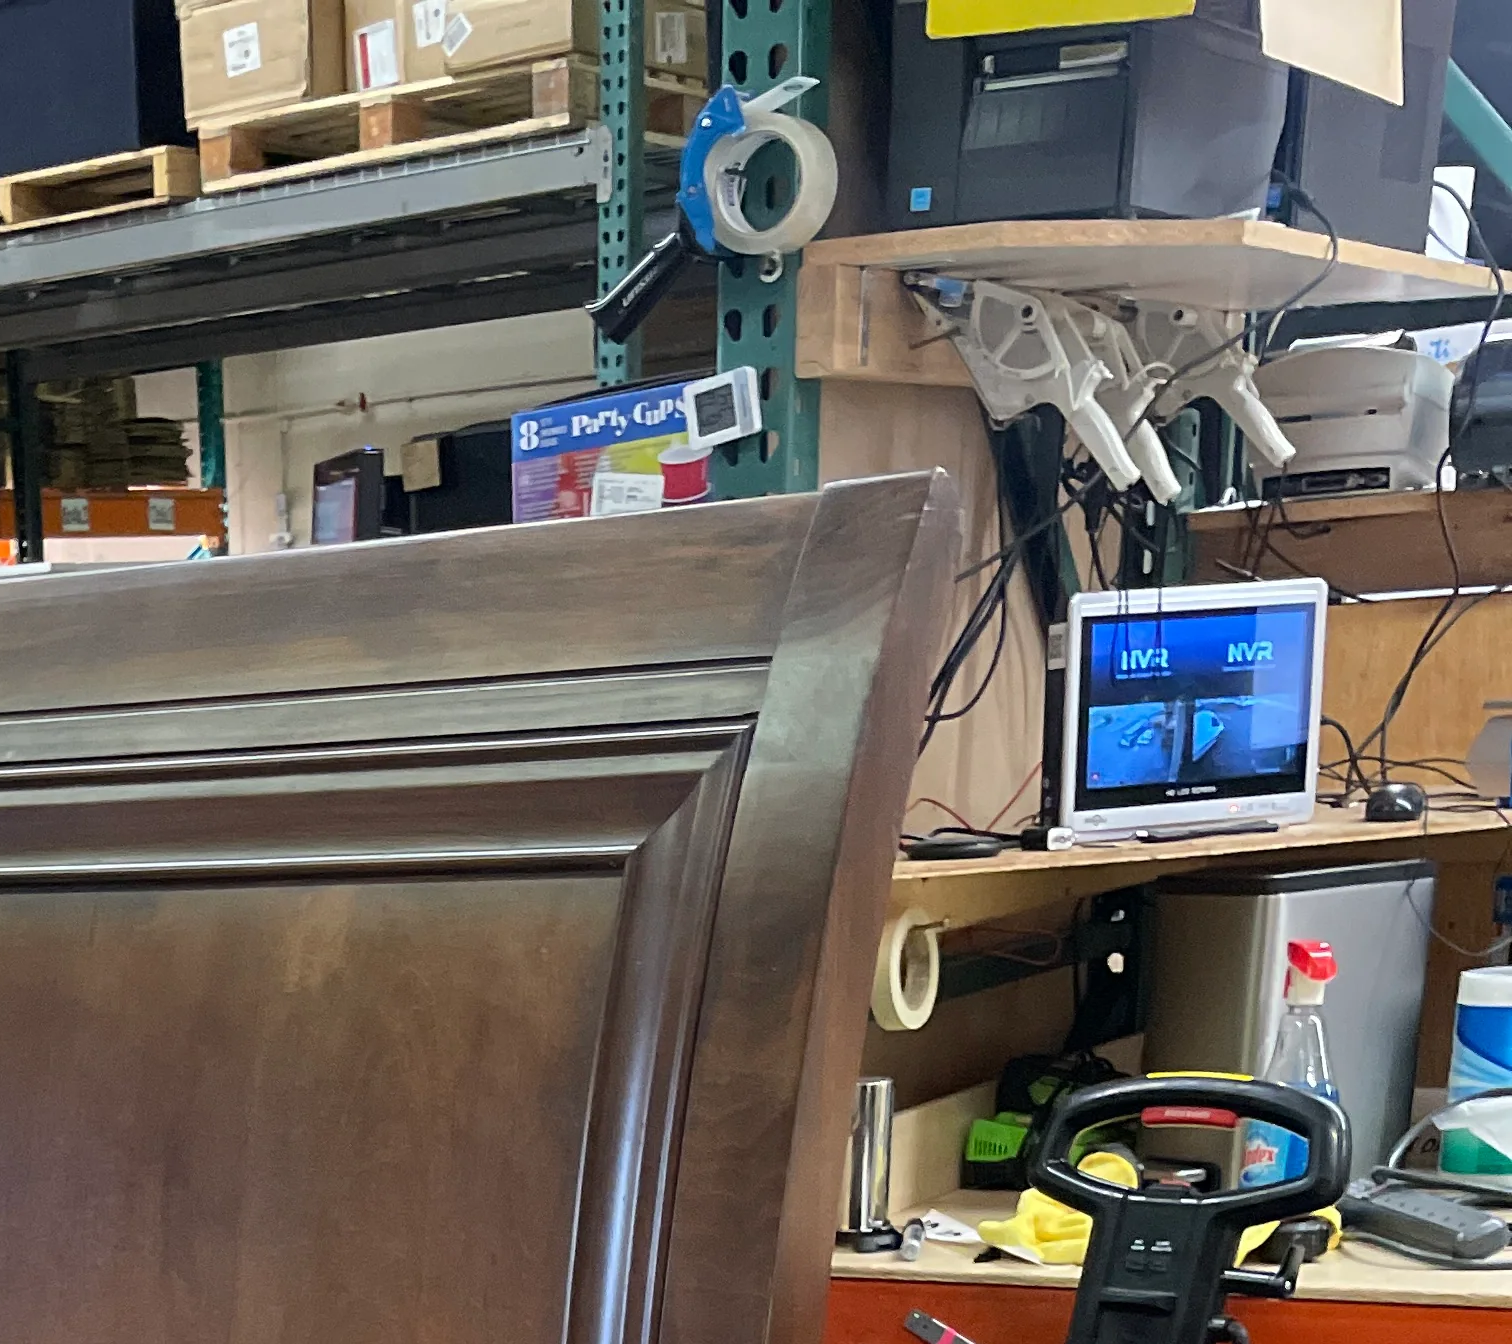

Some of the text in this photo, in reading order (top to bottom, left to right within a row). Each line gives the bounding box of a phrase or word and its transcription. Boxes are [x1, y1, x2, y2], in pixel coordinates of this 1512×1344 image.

[519, 419, 540, 451] 8
[570, 407, 628, 437] Party
[1227, 640, 1273, 663] NVR
